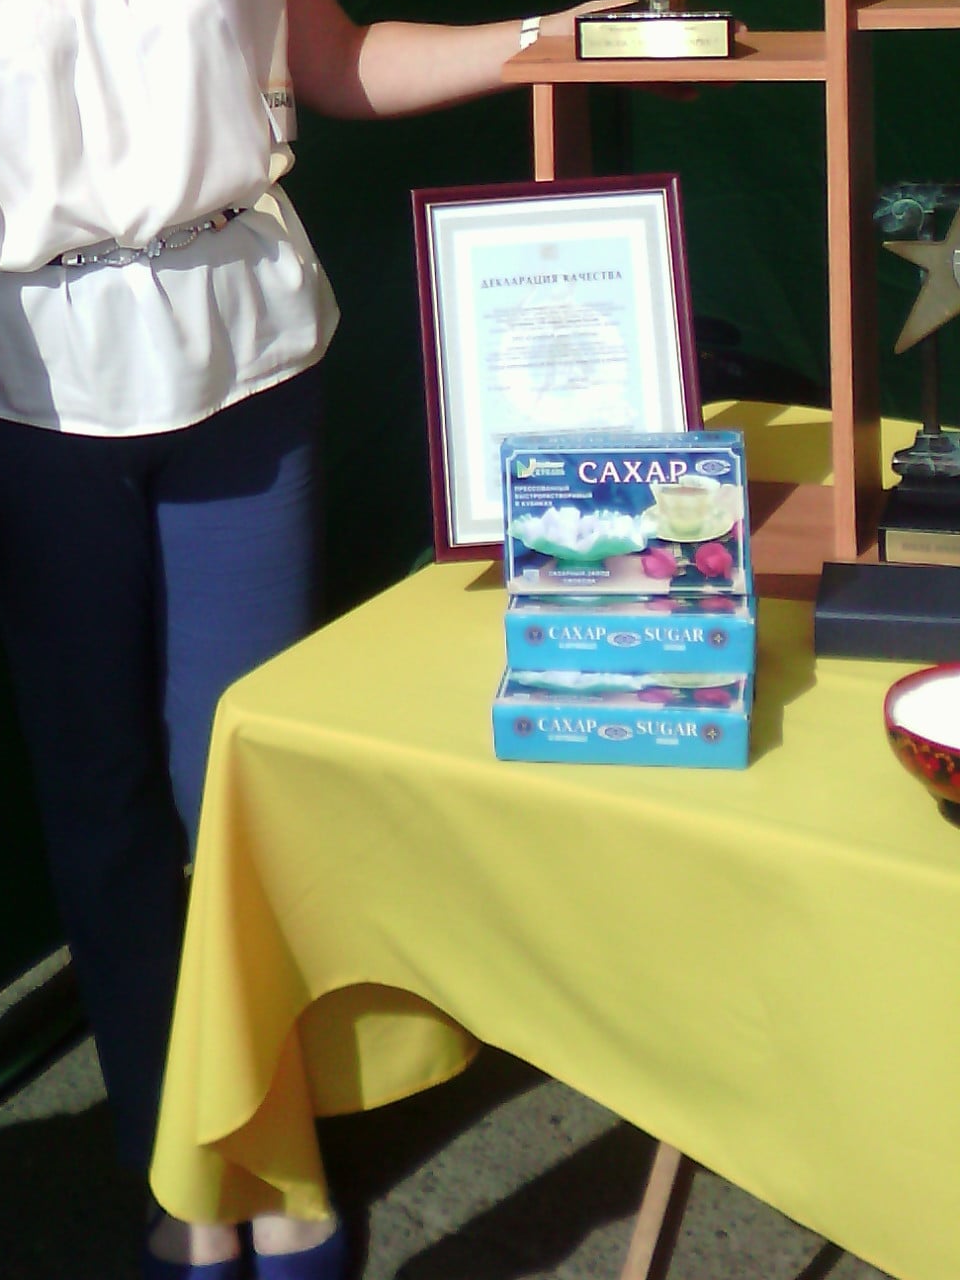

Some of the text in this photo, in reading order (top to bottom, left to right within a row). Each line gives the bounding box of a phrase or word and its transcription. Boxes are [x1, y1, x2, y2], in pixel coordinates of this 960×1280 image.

[480, 270, 622, 289] ДЕКЛАРАЦИЯ КАЧЕСТВА
[578, 460, 688, 484] САХАР
[548, 626, 607, 641] САХАР
[644, 627, 705, 643] SUGAR
[538, 719, 597, 734] САХАР
[636, 721, 698, 737] SUGAR
